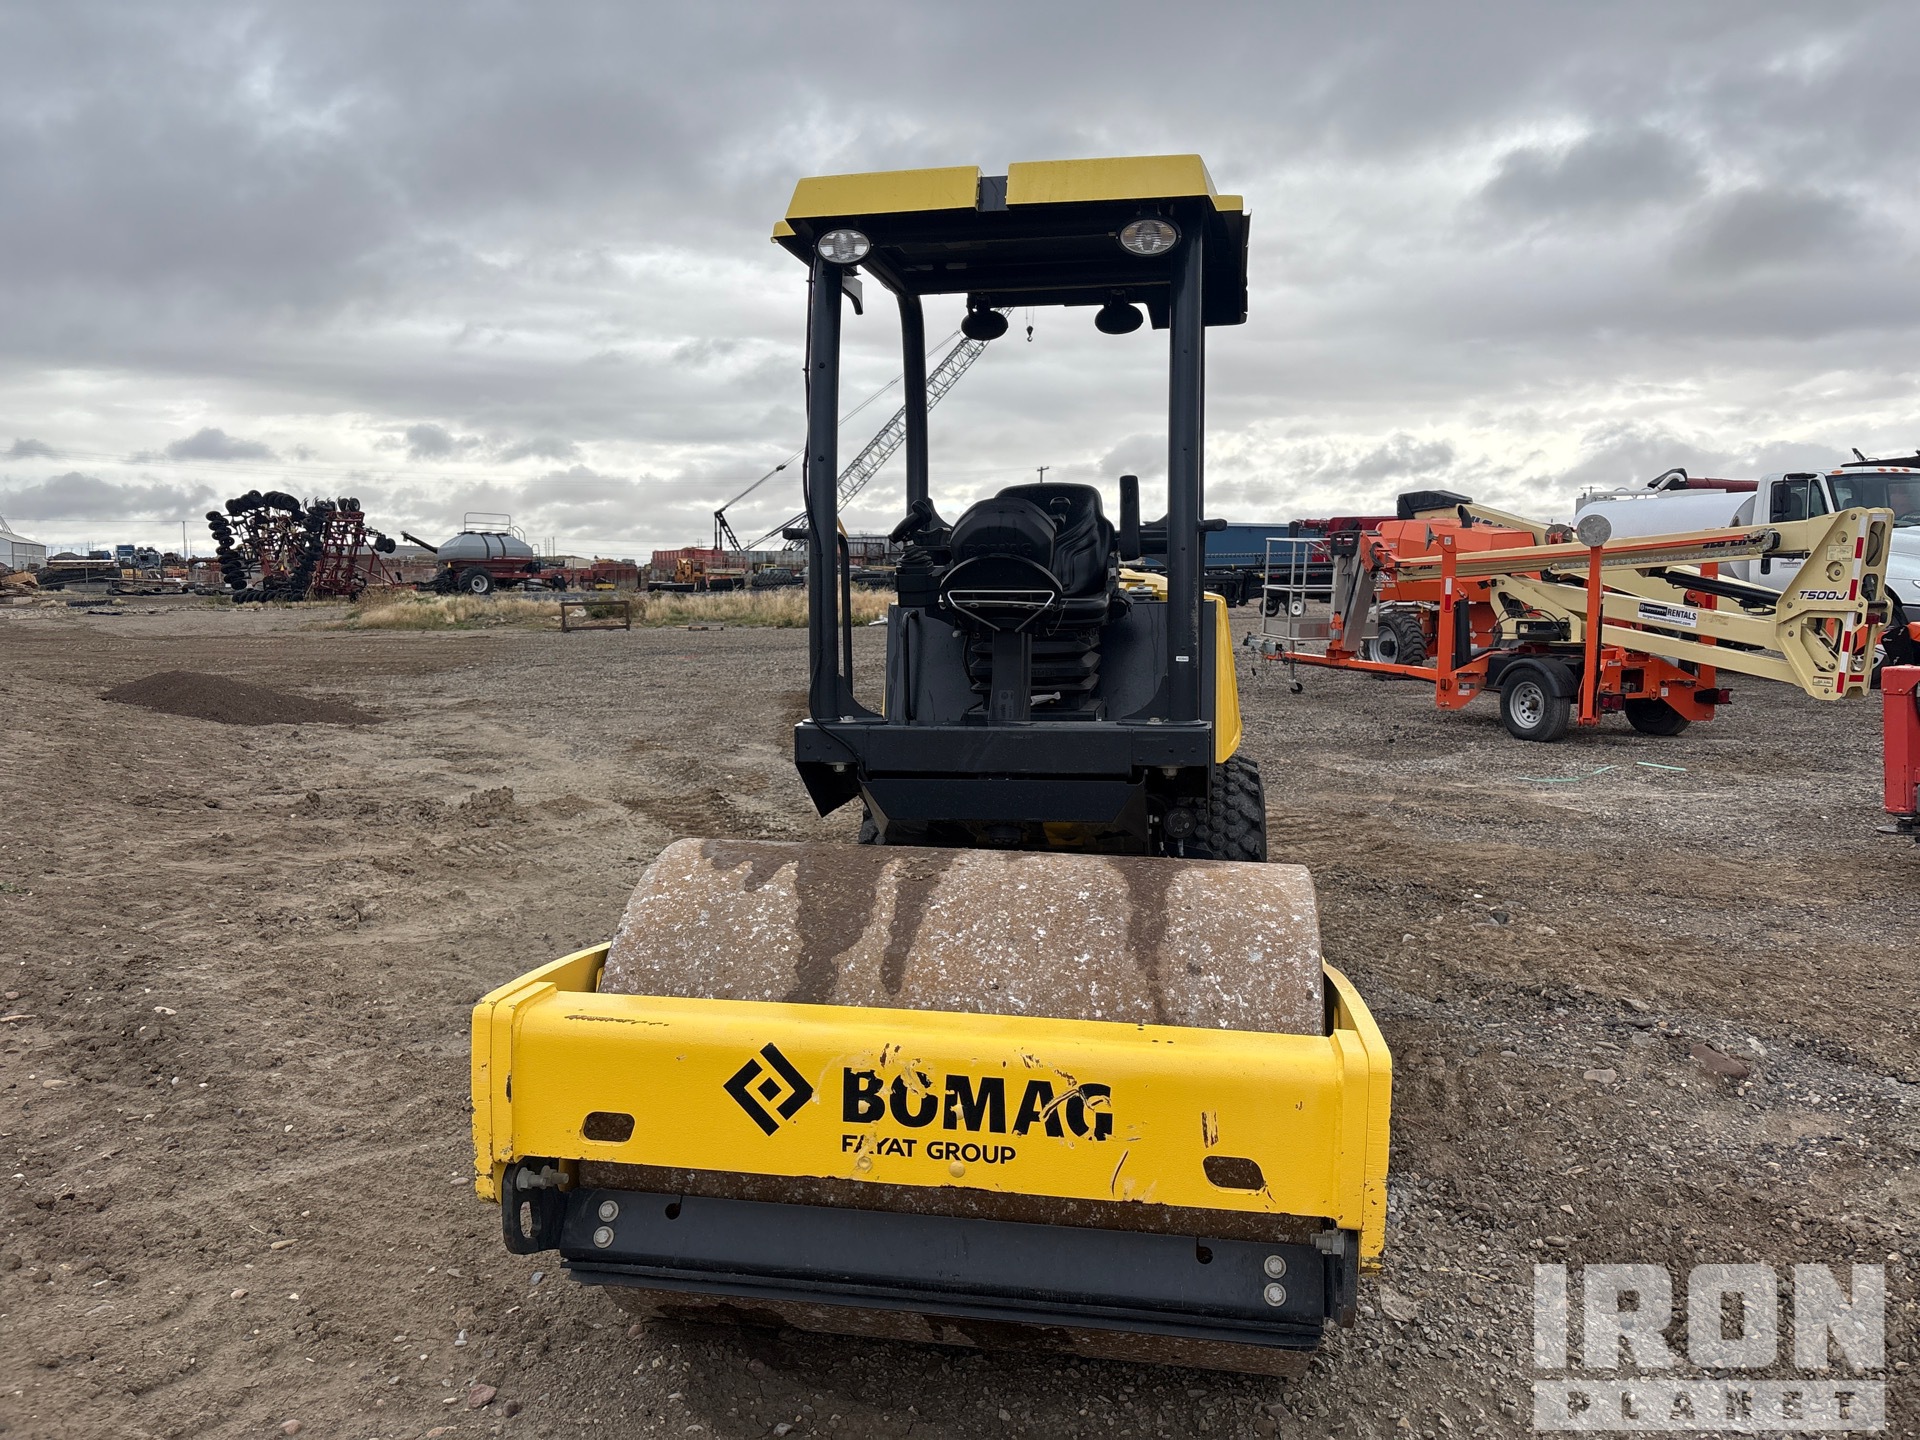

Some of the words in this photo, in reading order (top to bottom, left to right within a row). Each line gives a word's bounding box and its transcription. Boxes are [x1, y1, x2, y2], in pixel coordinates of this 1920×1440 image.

[1799, 590, 1848, 601] T500J
[1667, 608, 1697, 620] RENTALS
[841, 1066, 1114, 1142] BOMAG
[926, 1140, 1017, 1165] GROUP
